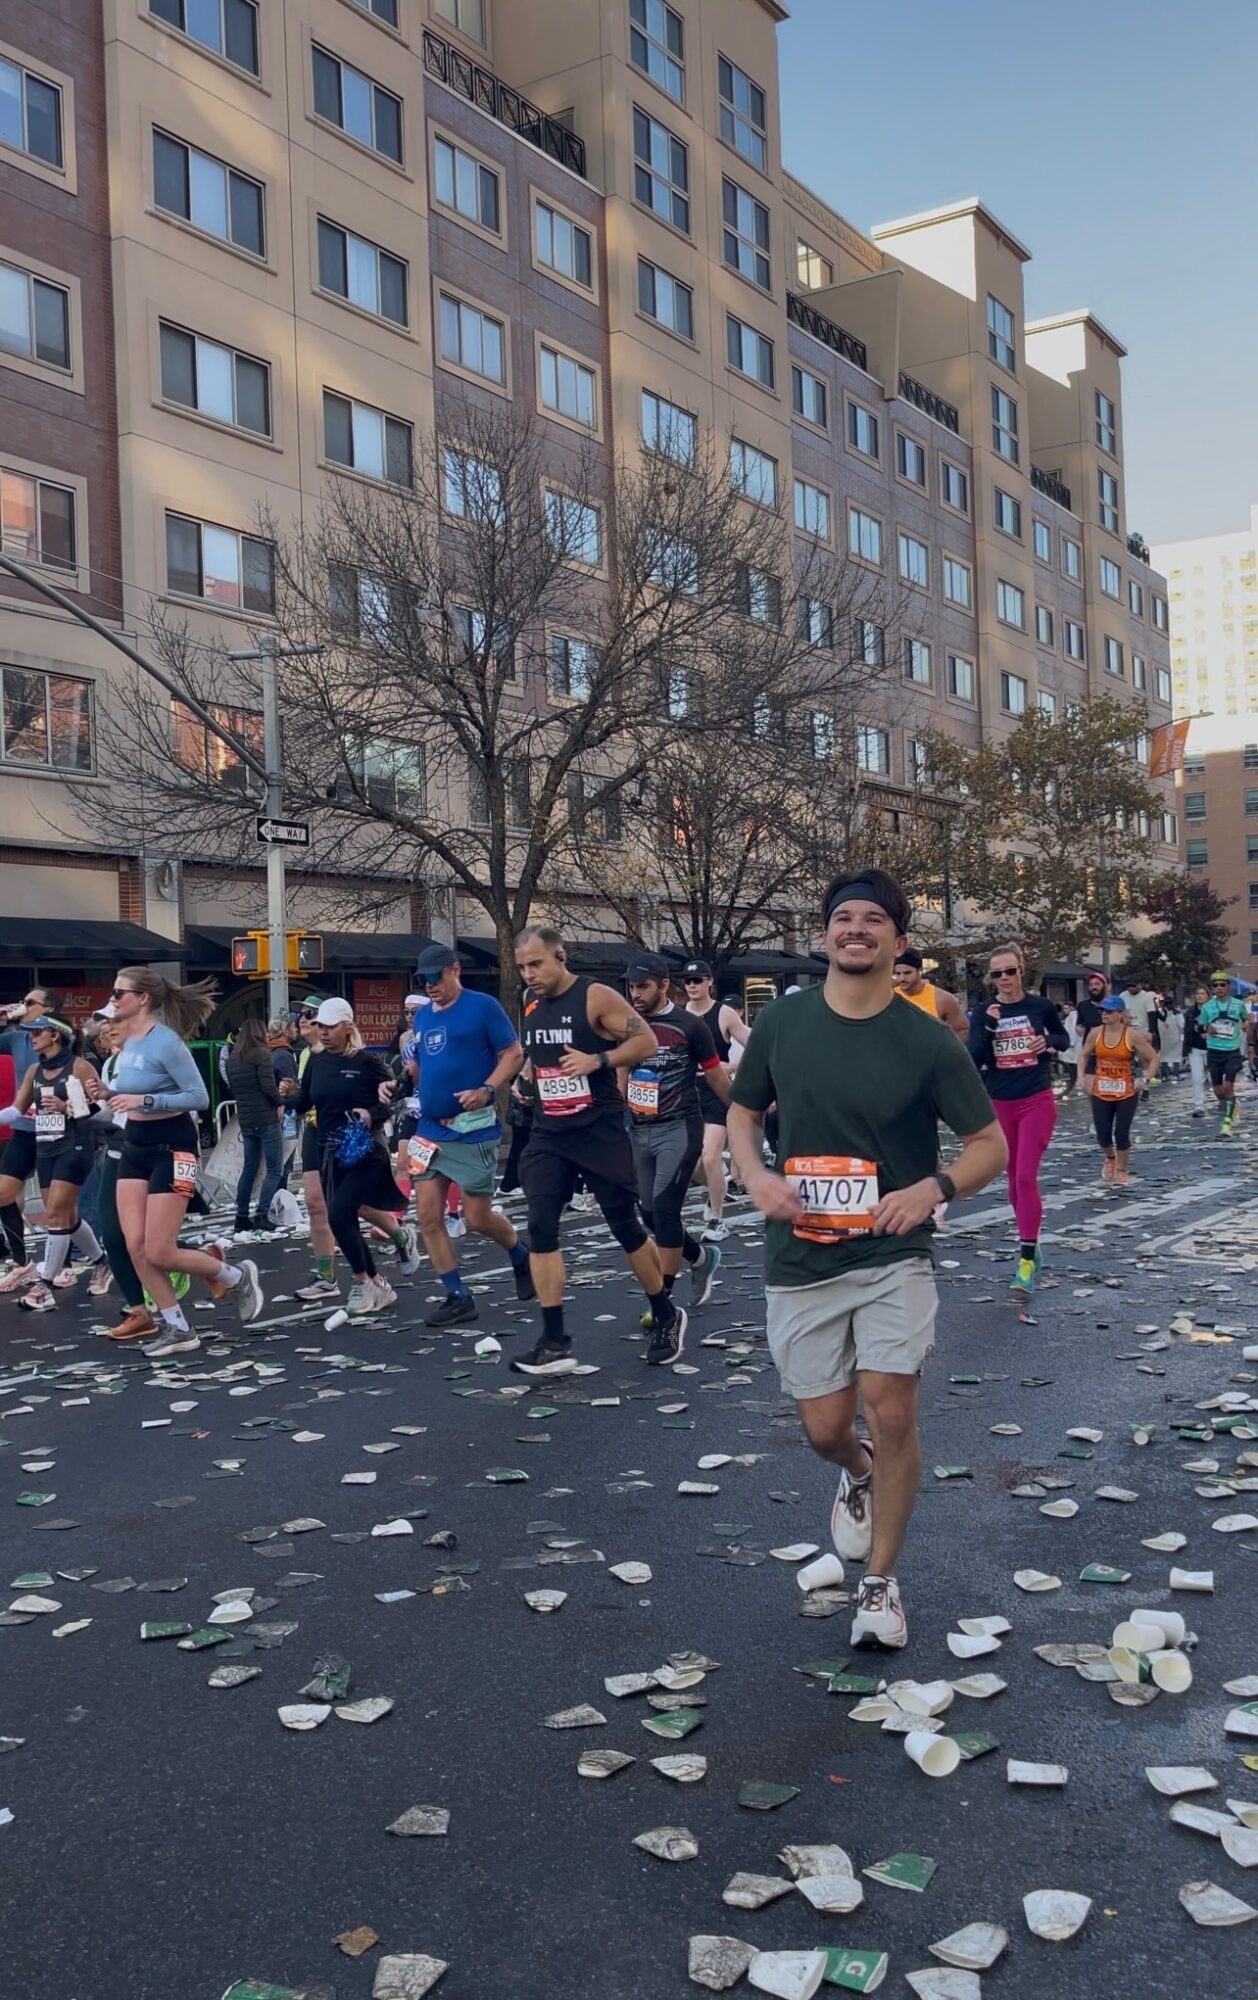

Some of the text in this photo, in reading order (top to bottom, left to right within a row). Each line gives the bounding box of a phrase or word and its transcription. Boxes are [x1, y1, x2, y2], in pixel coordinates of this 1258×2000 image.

[1171, 738, 1184, 769] ROUTE
[264, 825, 303, 839] ONE WAY
[356, 1003, 401, 1012] RETAIL SPACE
[356, 1015, 401, 1025] FOR LEASE
[525, 1029, 573, 1045] J FLYNN
[543, 1075, 585, 1094] 48951
[799, 1179, 867, 1205] 41707
[848, 1227, 870, 1235] 2024
